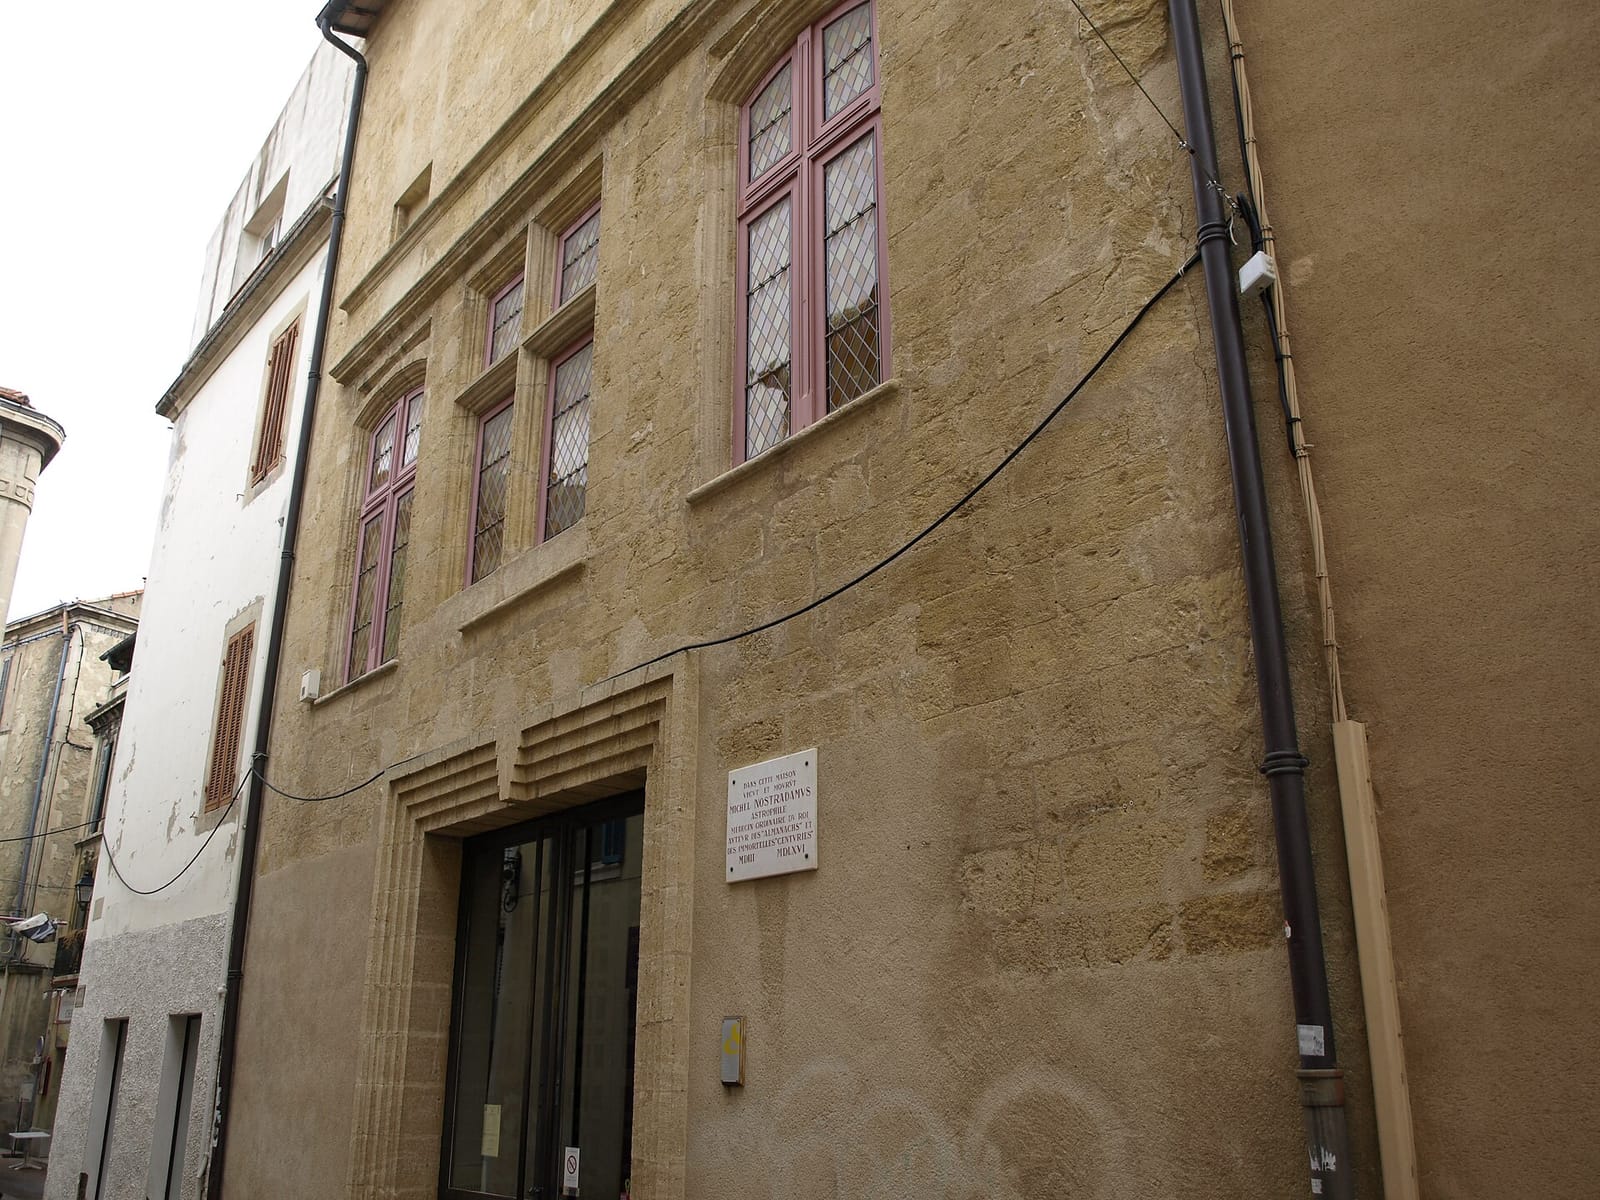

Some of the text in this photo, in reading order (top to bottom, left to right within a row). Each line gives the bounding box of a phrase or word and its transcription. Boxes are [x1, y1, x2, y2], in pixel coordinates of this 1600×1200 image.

[730, 786, 812, 815] MICHEL NOSTRADAMVS
[798, 811, 809, 820] ROI
